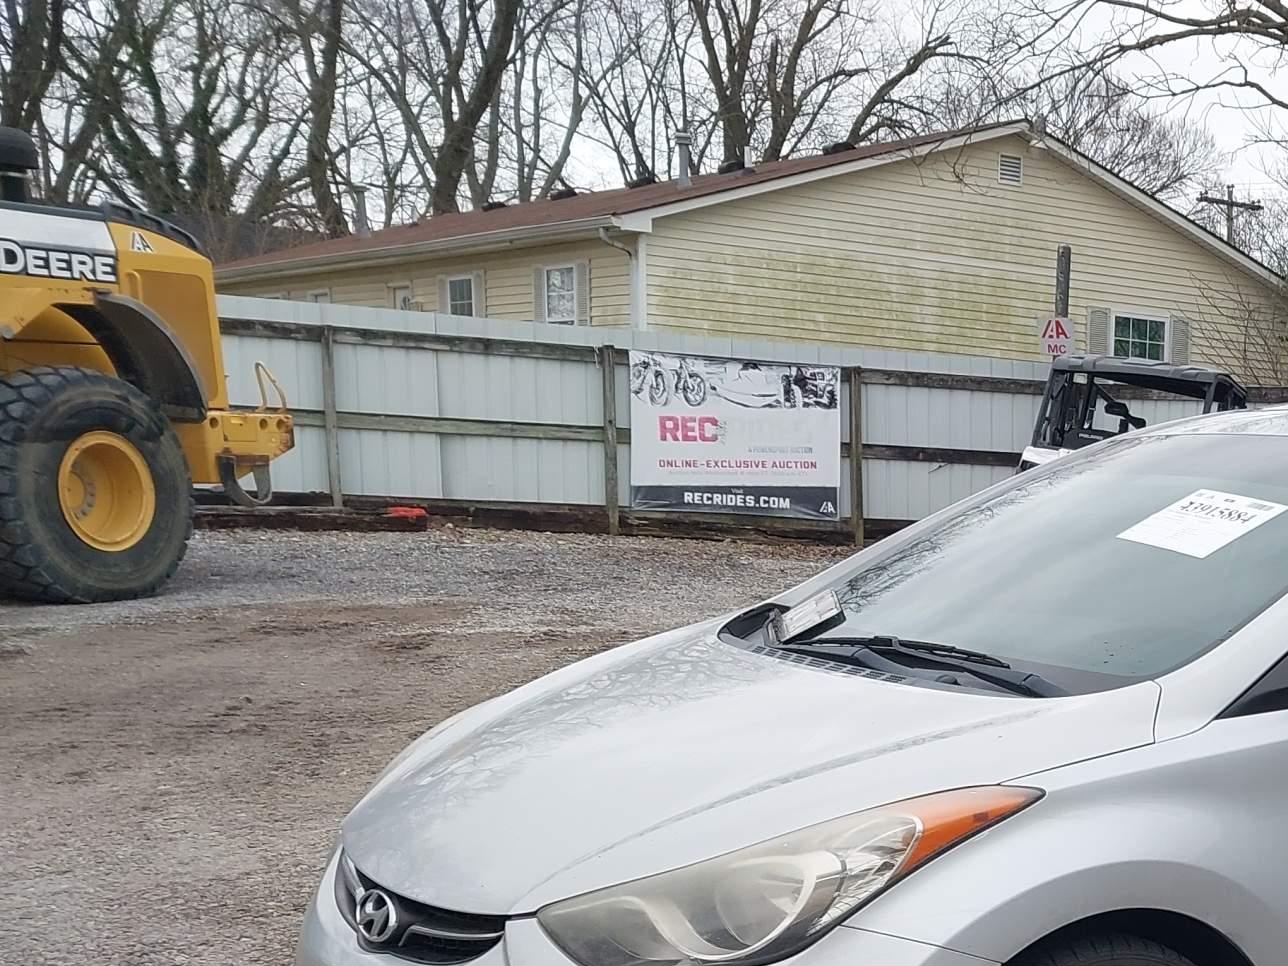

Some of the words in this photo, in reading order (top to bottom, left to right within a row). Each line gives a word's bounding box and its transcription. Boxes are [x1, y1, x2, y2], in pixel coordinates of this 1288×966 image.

[0, 240, 117, 282] DEERE
[1047, 343, 1067, 354] MC
[658, 459, 768, 469] ONLINE-EXCLUSIVE
[771, 460, 817, 470] AUCTION
[684, 492, 791, 509] RECRIDES.COM
